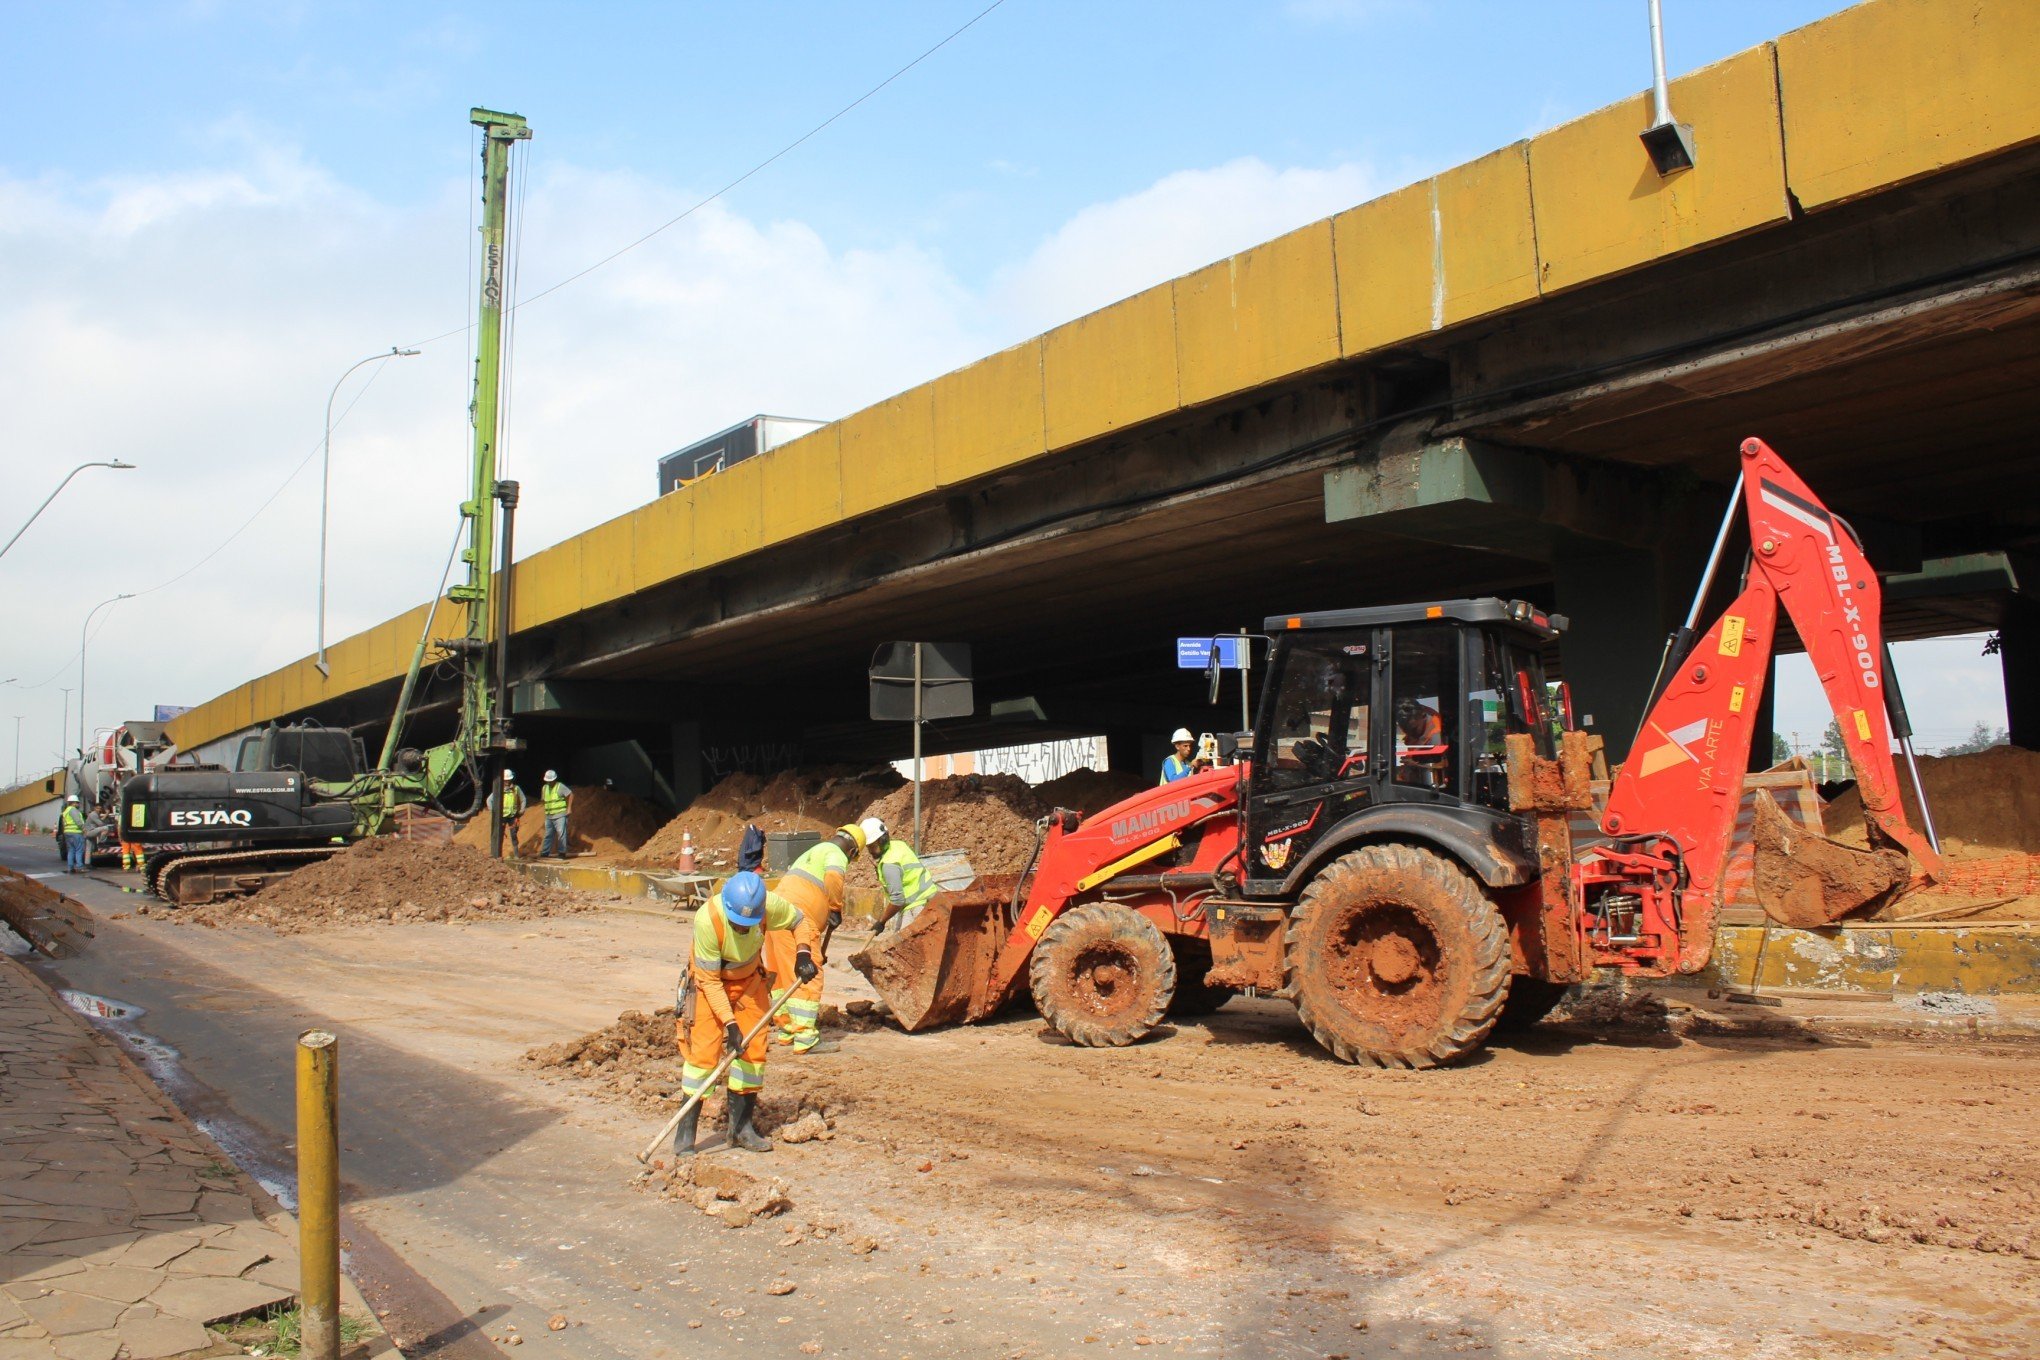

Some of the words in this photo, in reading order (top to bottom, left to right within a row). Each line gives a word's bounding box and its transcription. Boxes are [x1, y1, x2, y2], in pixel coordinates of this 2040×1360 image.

[485, 244, 498, 301] ESTAQ
[1826, 545, 1878, 688] MBL-X-900
[1704, 718, 1723, 760] ARTE
[287, 777, 295, 786] 9
[1697, 766, 1713, 790] VIA
[170, 809, 252, 826] ESTAQ
[1112, 799, 1191, 838] MANITOU
[1267, 819, 1309, 836] MBL-X-900
